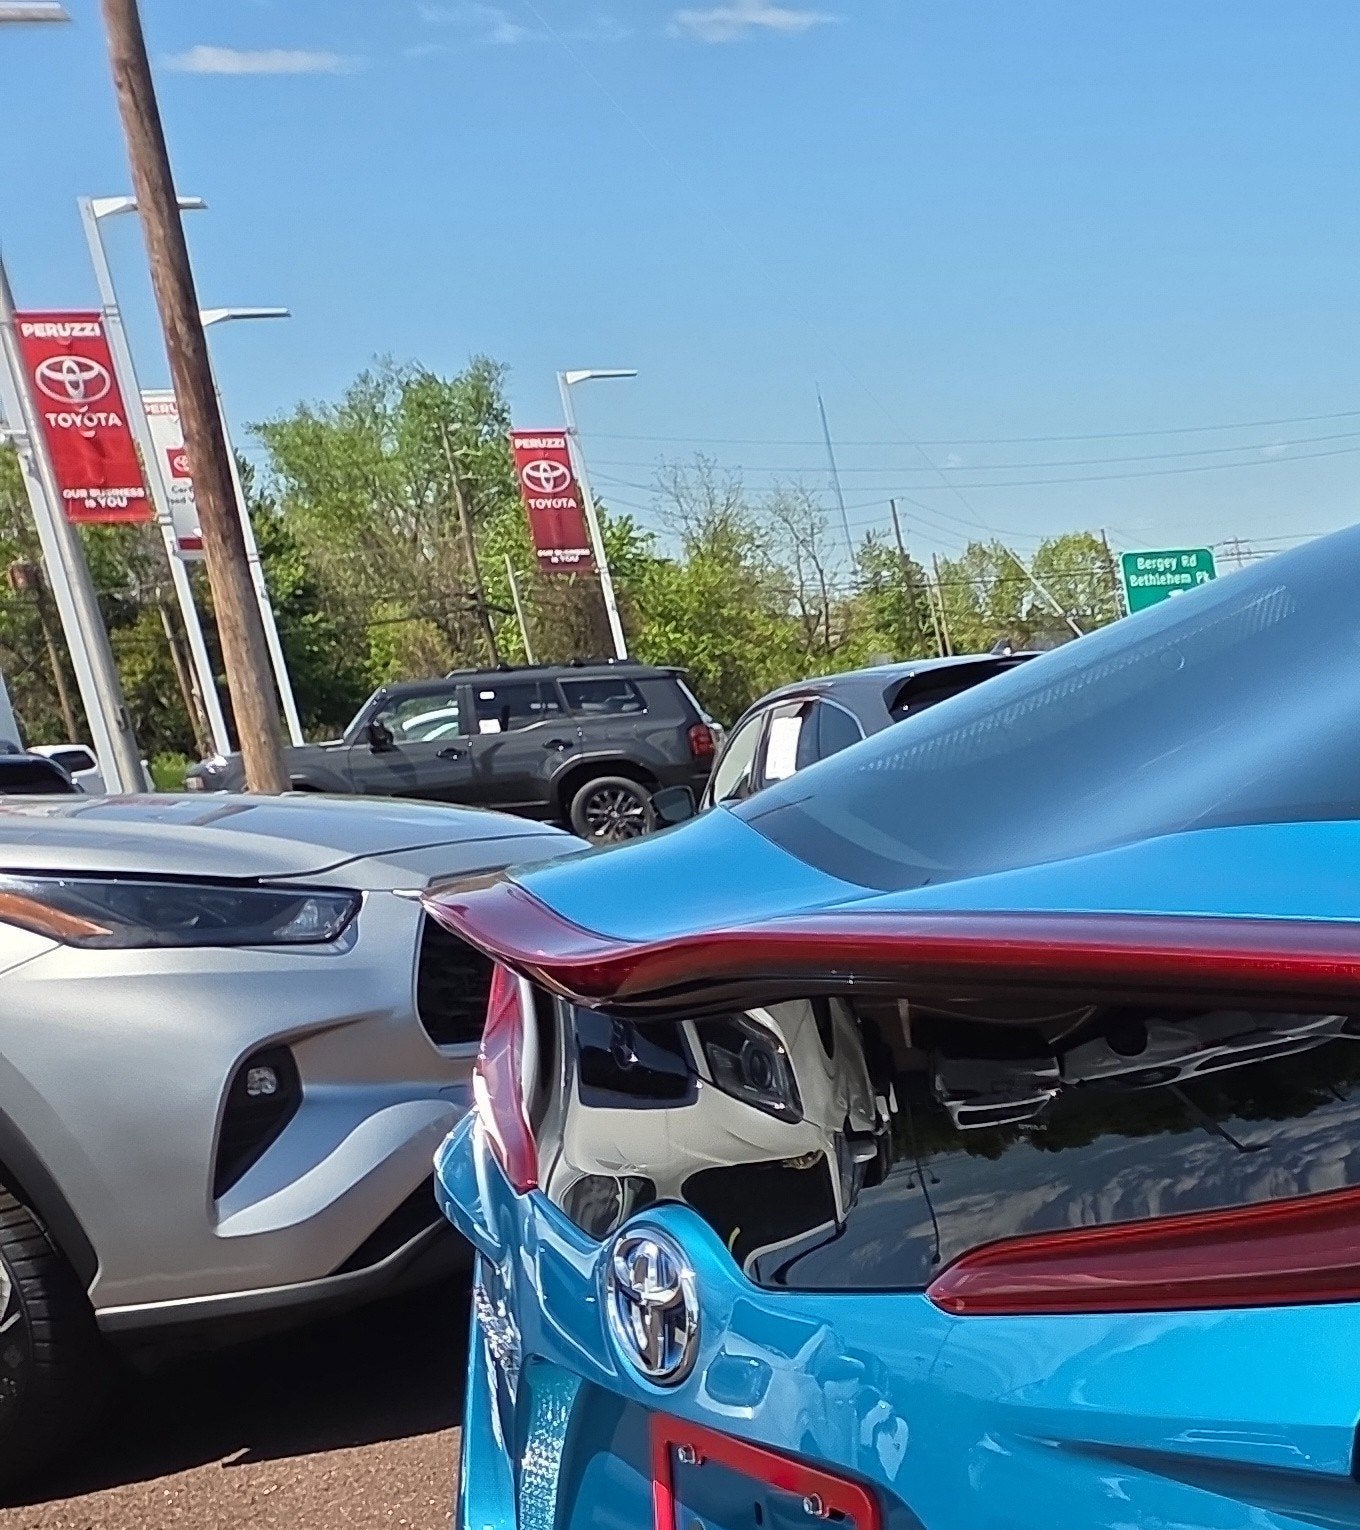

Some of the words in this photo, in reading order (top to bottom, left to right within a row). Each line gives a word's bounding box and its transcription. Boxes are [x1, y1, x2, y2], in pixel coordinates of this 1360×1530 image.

[21, 322, 101, 338] PERUZZI
[45, 412, 122, 429] TOYOTA
[97, 497, 128, 508] YOU
[528, 498, 577, 509] TOYOTA
[1136, 557, 1177, 571] Bergey
[1129, 572, 1192, 587] Bethlehem
